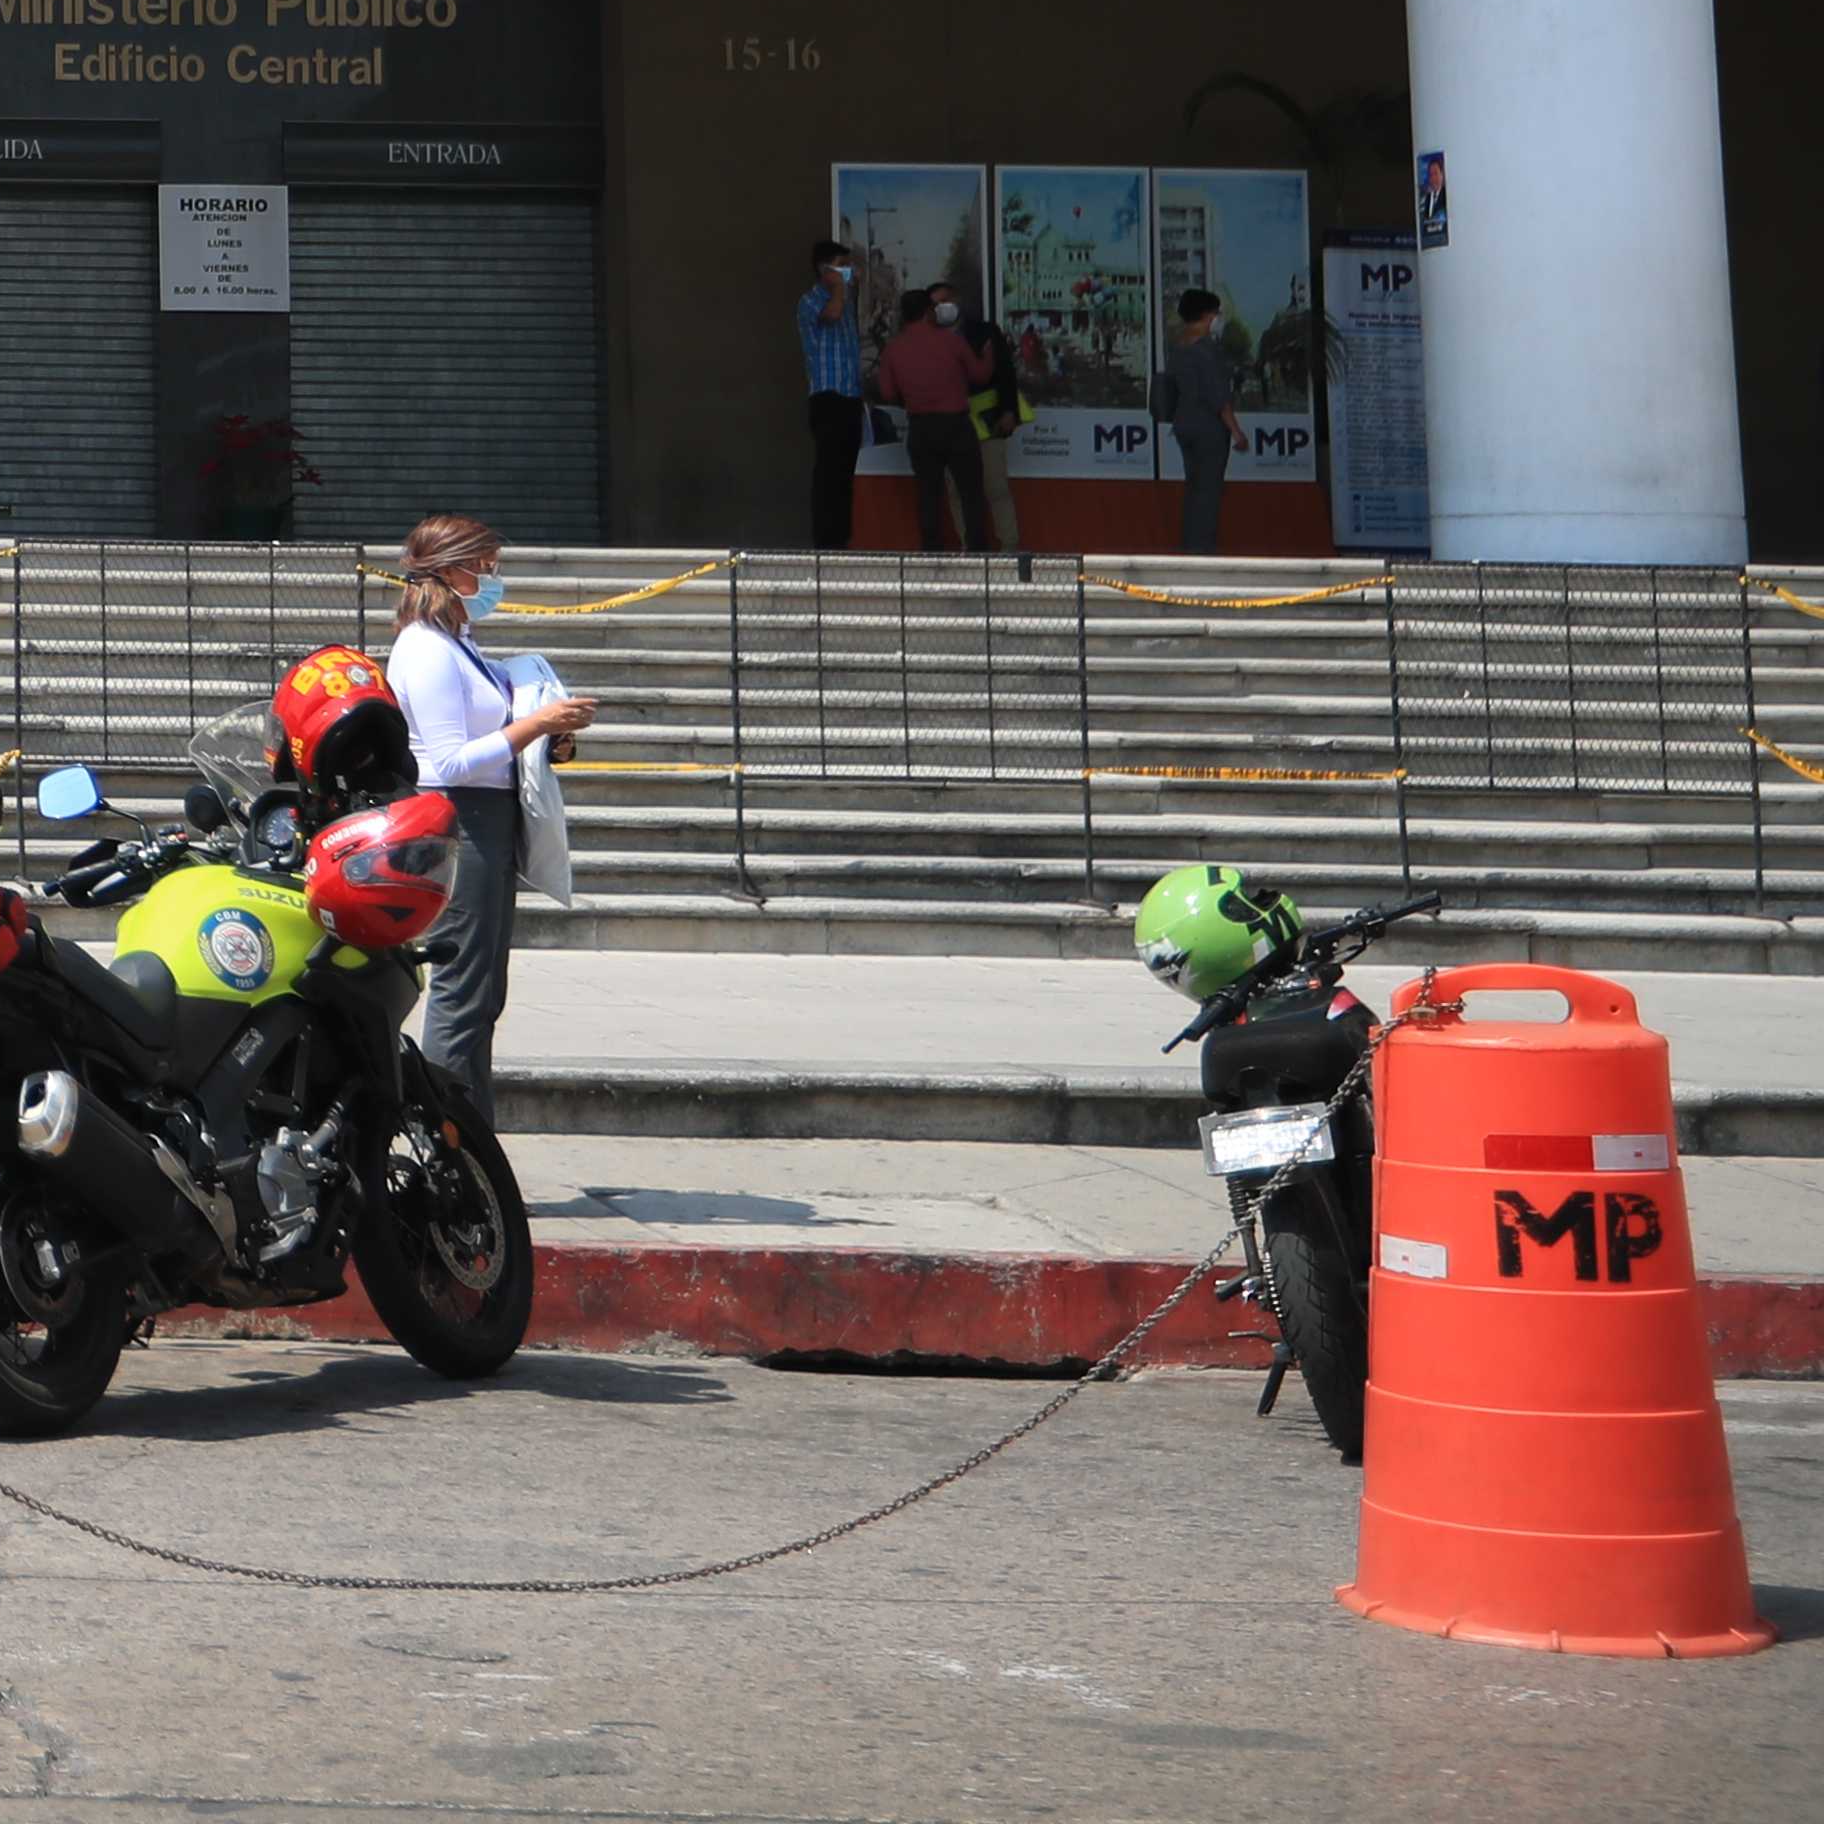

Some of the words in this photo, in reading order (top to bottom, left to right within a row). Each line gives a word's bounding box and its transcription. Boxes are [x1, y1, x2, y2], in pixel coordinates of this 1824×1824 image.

[54, 43, 205, 83] Edificio
[227, 45, 383, 86] Central
[387, 142, 502, 166] ENTRADA
[179, 198, 268, 212] HORARIO
[216, 228, 231, 236] DE
[207, 240, 243, 248] LUNES
[221, 252, 229, 261] A
[202, 264, 249, 273] VIERNES
[217, 274, 232, 283] DE
[1361, 263, 1413, 292] MP
[202, 286, 210, 294] A
[1094, 424, 1148, 453] MP
[1255, 427, 1309, 456] MP
[237, 887, 307, 910] SUZU
[215, 910, 242, 923] CBM
[1494, 1190, 1664, 1283] MP
